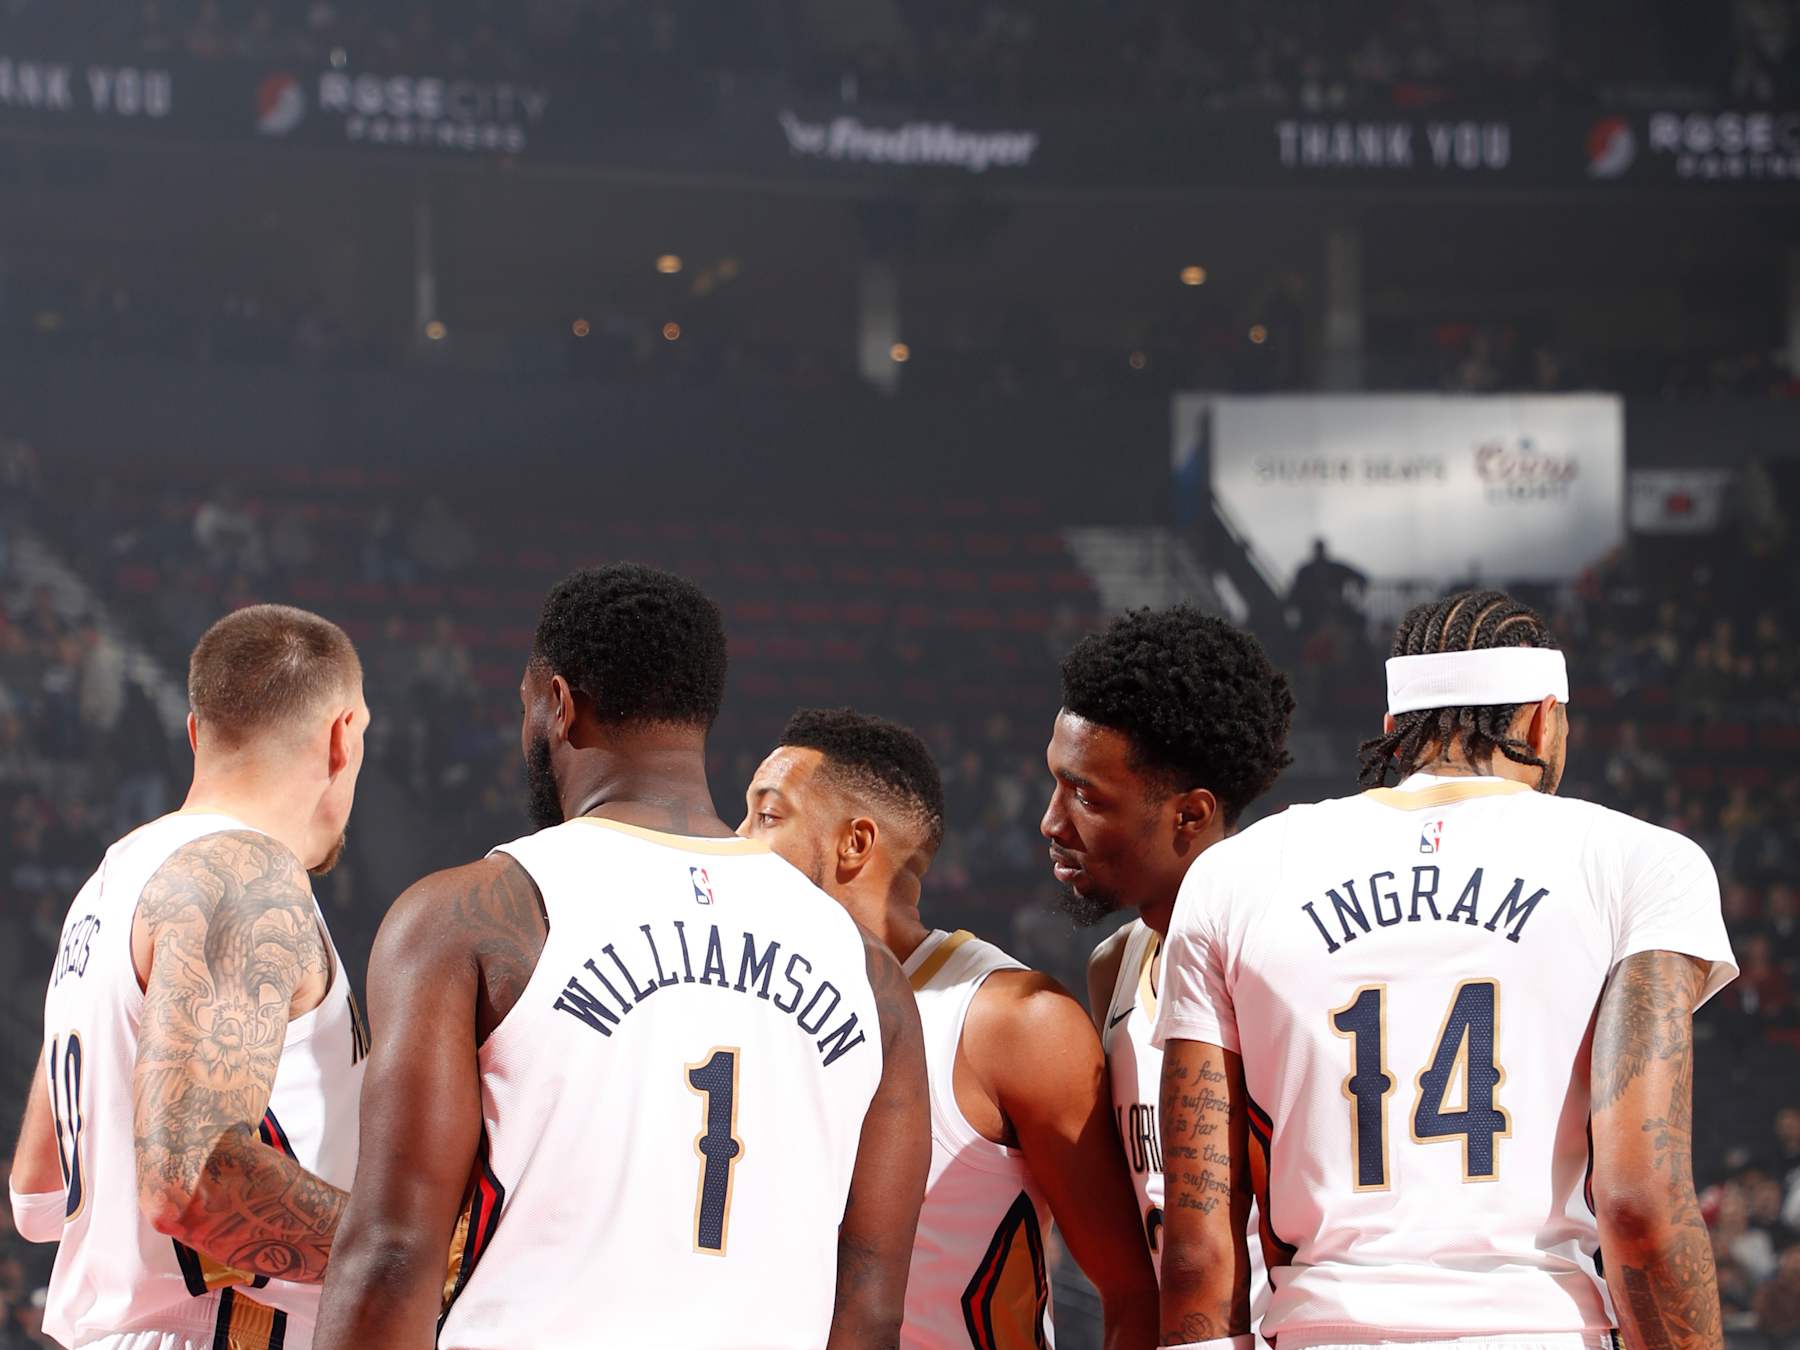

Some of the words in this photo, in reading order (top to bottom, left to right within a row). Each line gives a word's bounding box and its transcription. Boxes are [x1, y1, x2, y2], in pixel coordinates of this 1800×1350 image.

[87, 65, 173, 117] YOU
[1276, 121, 1413, 170] THANK
[1427, 122, 1512, 170] YOU
[1302, 865, 1549, 954] INGRAM
[552, 921, 866, 1068] WILLIAMSON
[1194, 1060, 1226, 1086] fear
[1327, 977, 1513, 1194] 14
[683, 1044, 746, 1258] 1
[1191, 1115, 1218, 1140] far
